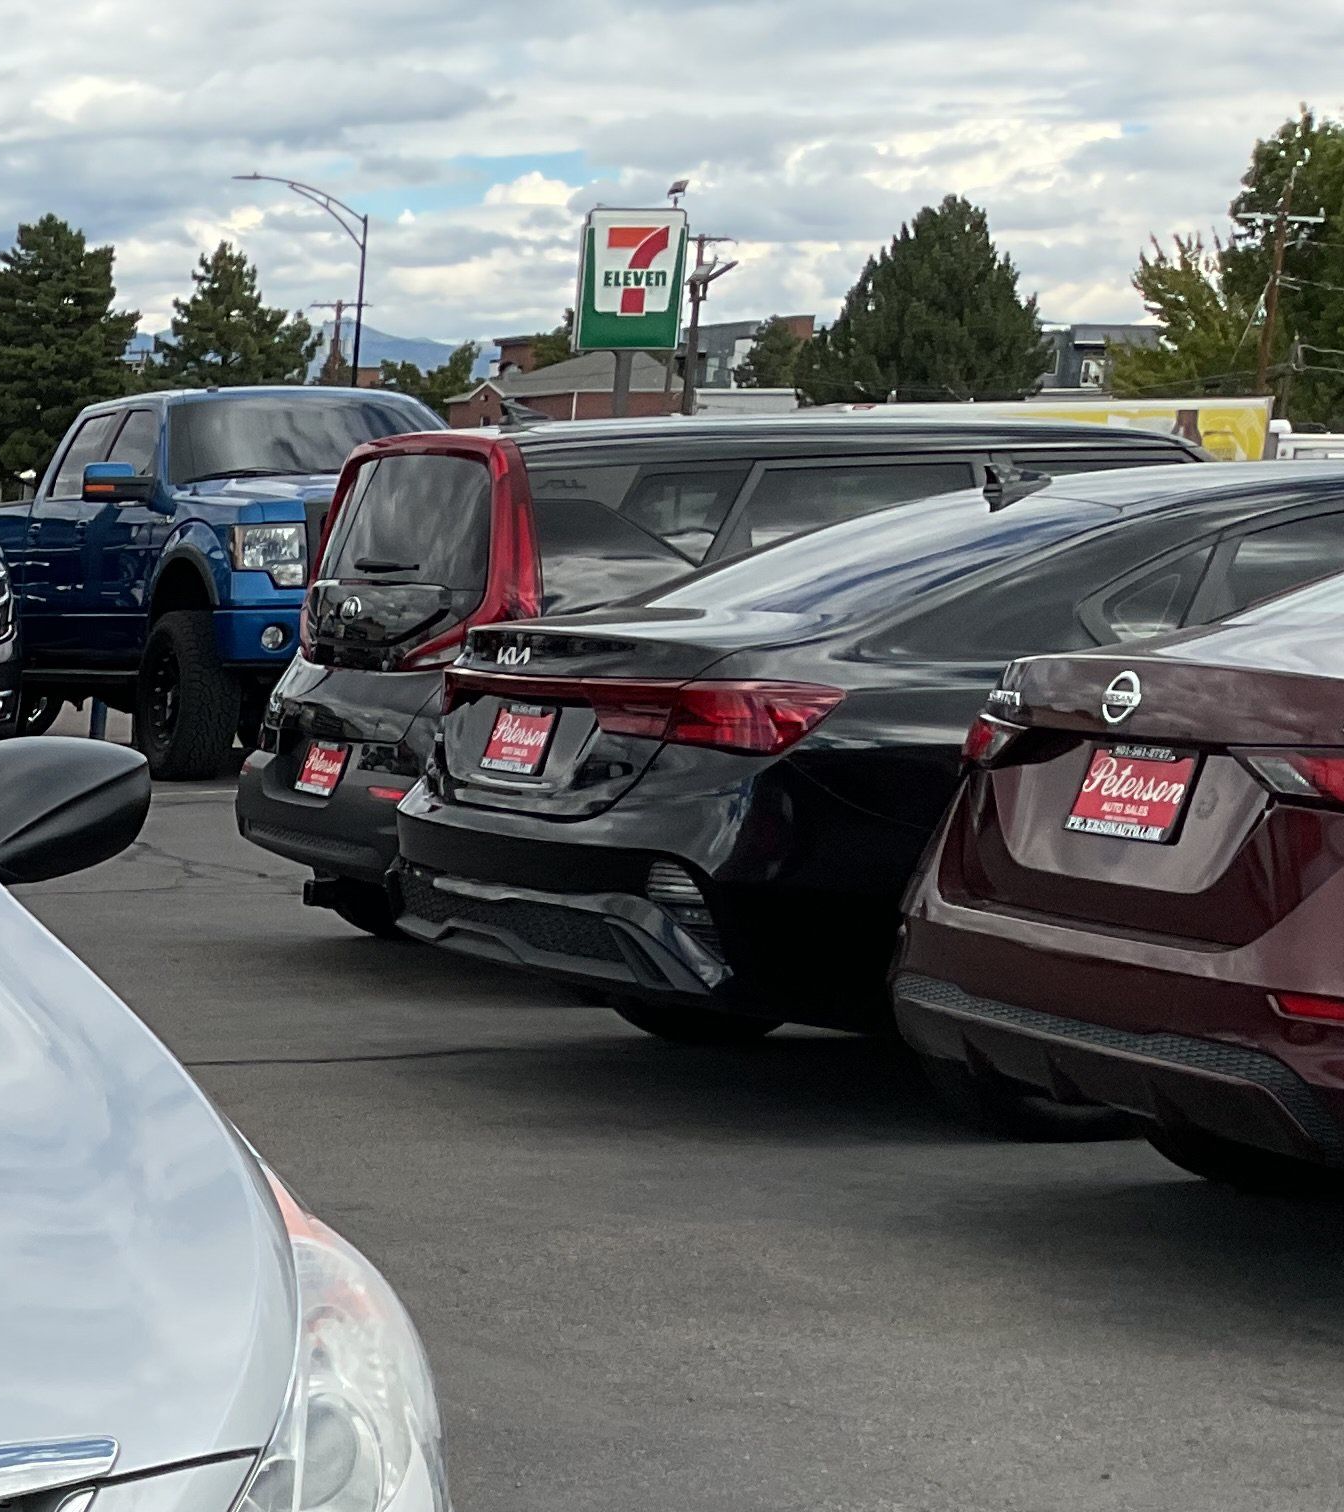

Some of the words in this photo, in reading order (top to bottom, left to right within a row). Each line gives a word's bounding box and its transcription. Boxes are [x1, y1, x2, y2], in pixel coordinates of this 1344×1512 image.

[608, 226, 670, 314] 7
[497, 646, 531, 665] KIA
[492, 713, 548, 748] Peterson
[1083, 757, 1185, 804] Peterson
[1100, 802, 1123, 813] AUTO
[1124, 804, 1149, 817] SALES
